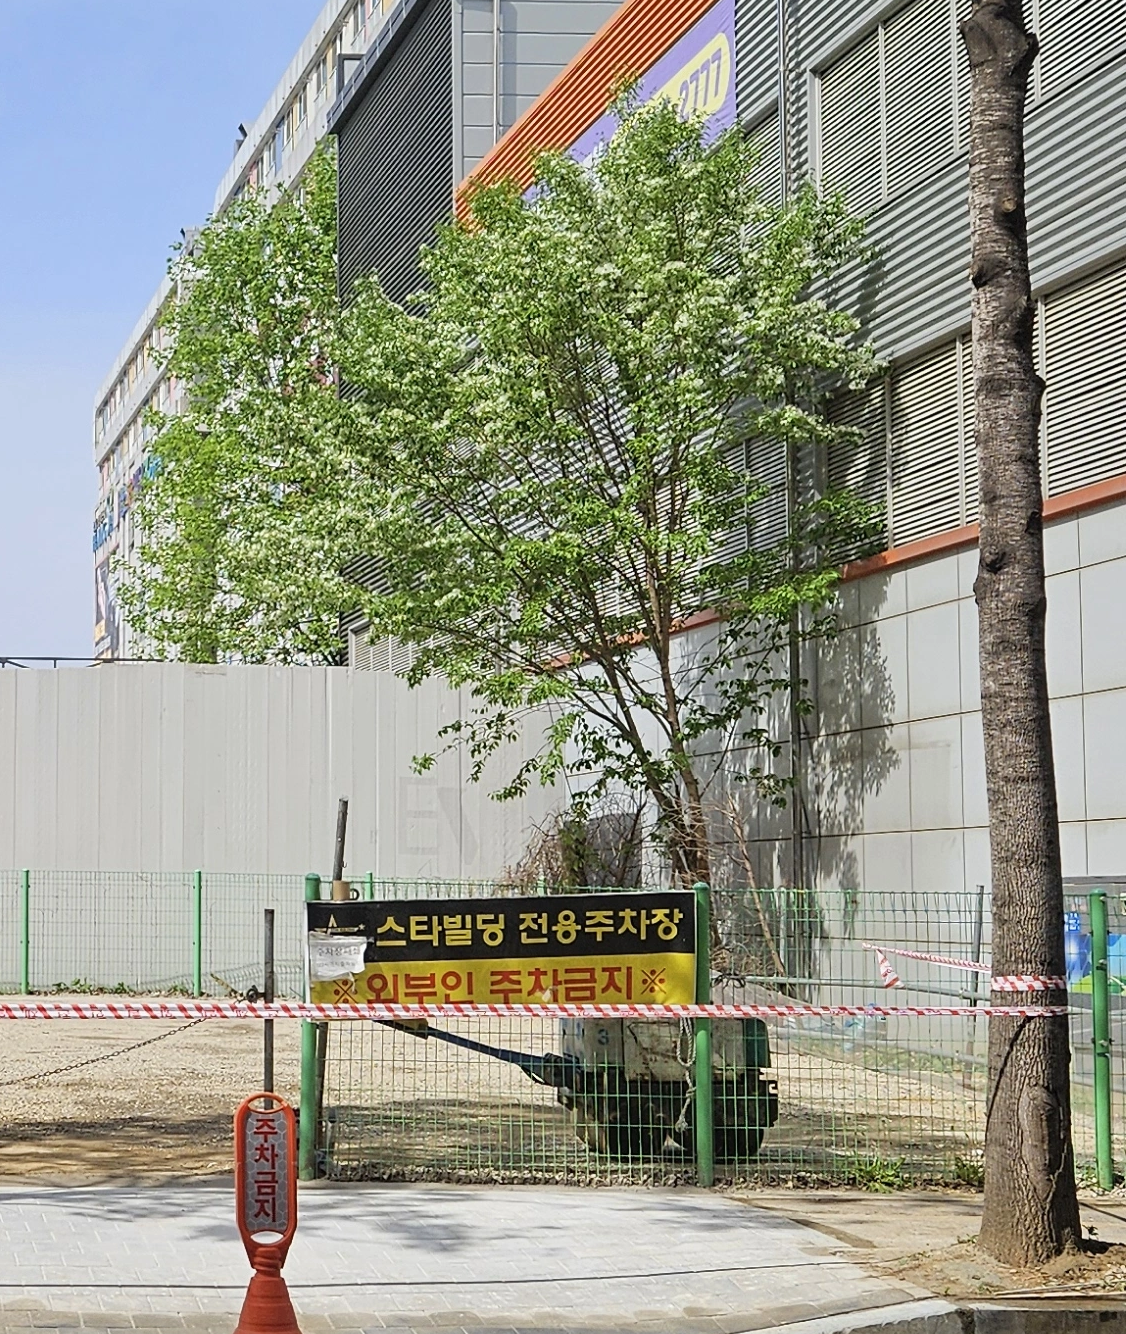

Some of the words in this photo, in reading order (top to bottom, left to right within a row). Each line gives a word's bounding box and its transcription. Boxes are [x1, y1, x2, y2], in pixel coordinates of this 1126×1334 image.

[376, 913, 505, 947] 스타빌딩
[519, 908, 683, 945] 전용주차장
[366, 969, 474, 1005] 외부인
[489, 965, 633, 1005] 주차금지
[253, 1118, 279, 1223] 주차금지
